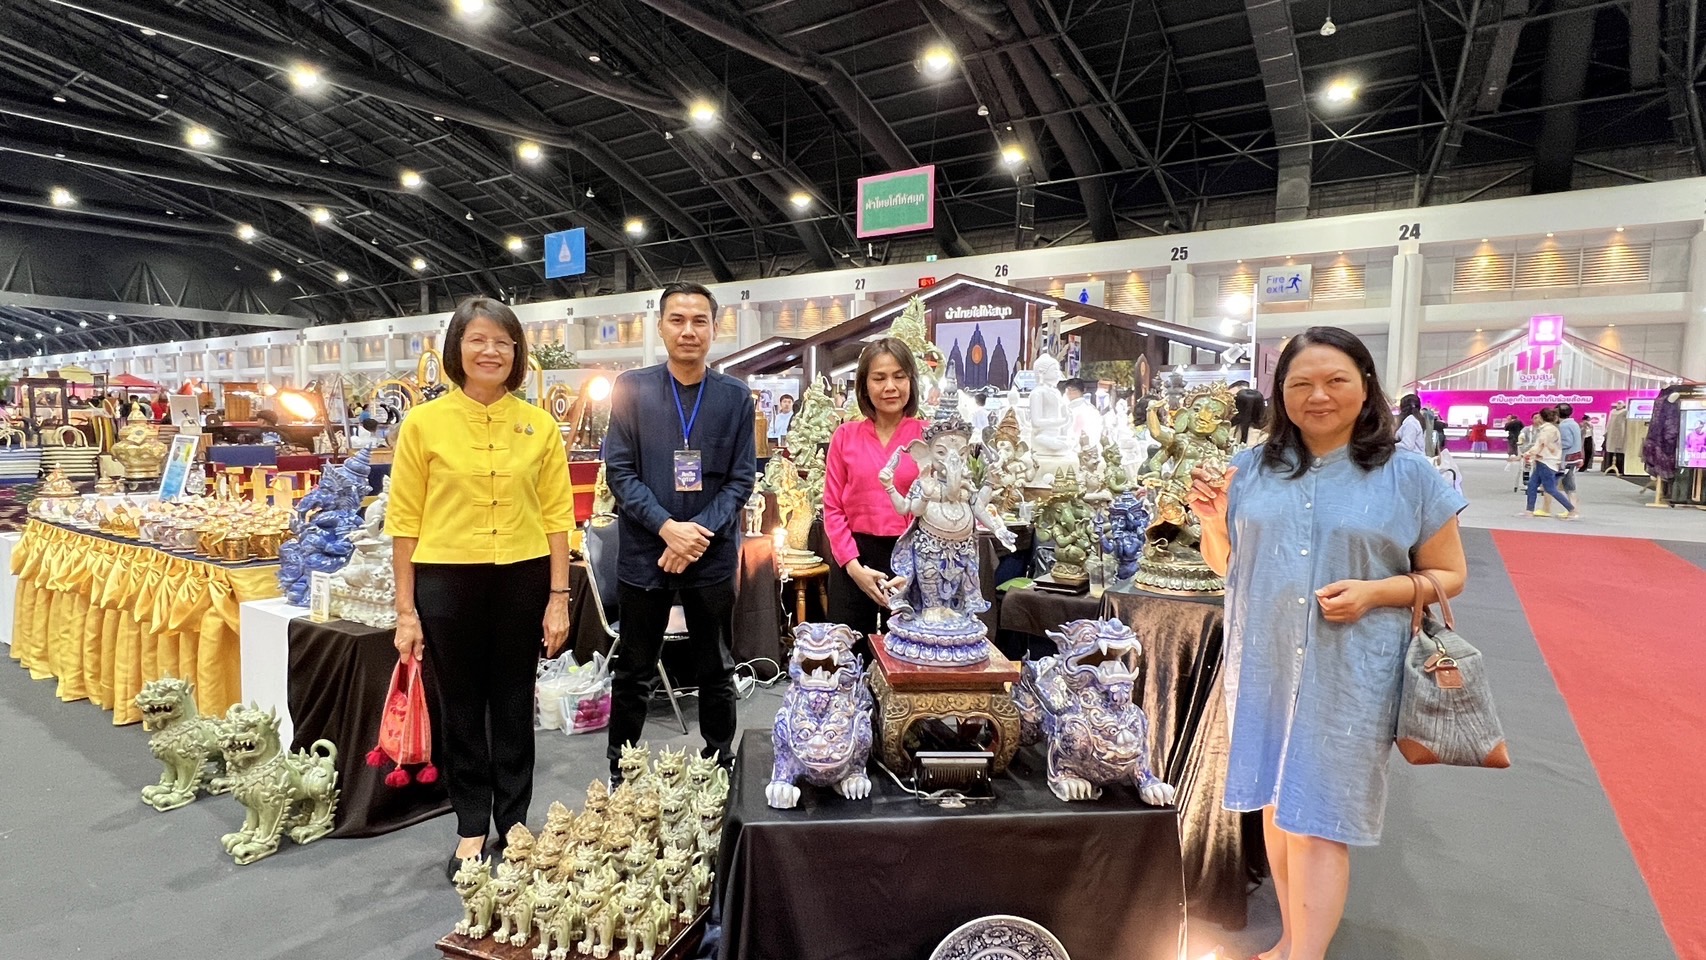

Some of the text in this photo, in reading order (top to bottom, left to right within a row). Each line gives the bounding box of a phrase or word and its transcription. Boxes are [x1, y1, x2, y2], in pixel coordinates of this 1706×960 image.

[1399, 224, 1421, 240] 24
[1171, 246, 1188, 261] 25
[995, 265, 1009, 277] 26
[855, 279, 866, 290] 27
[1266, 276, 1285, 285] Fire
[1266, 284, 1284, 294] exit
[945, 304, 1012, 319] ผ้าไทยใส่ให้สนุก
